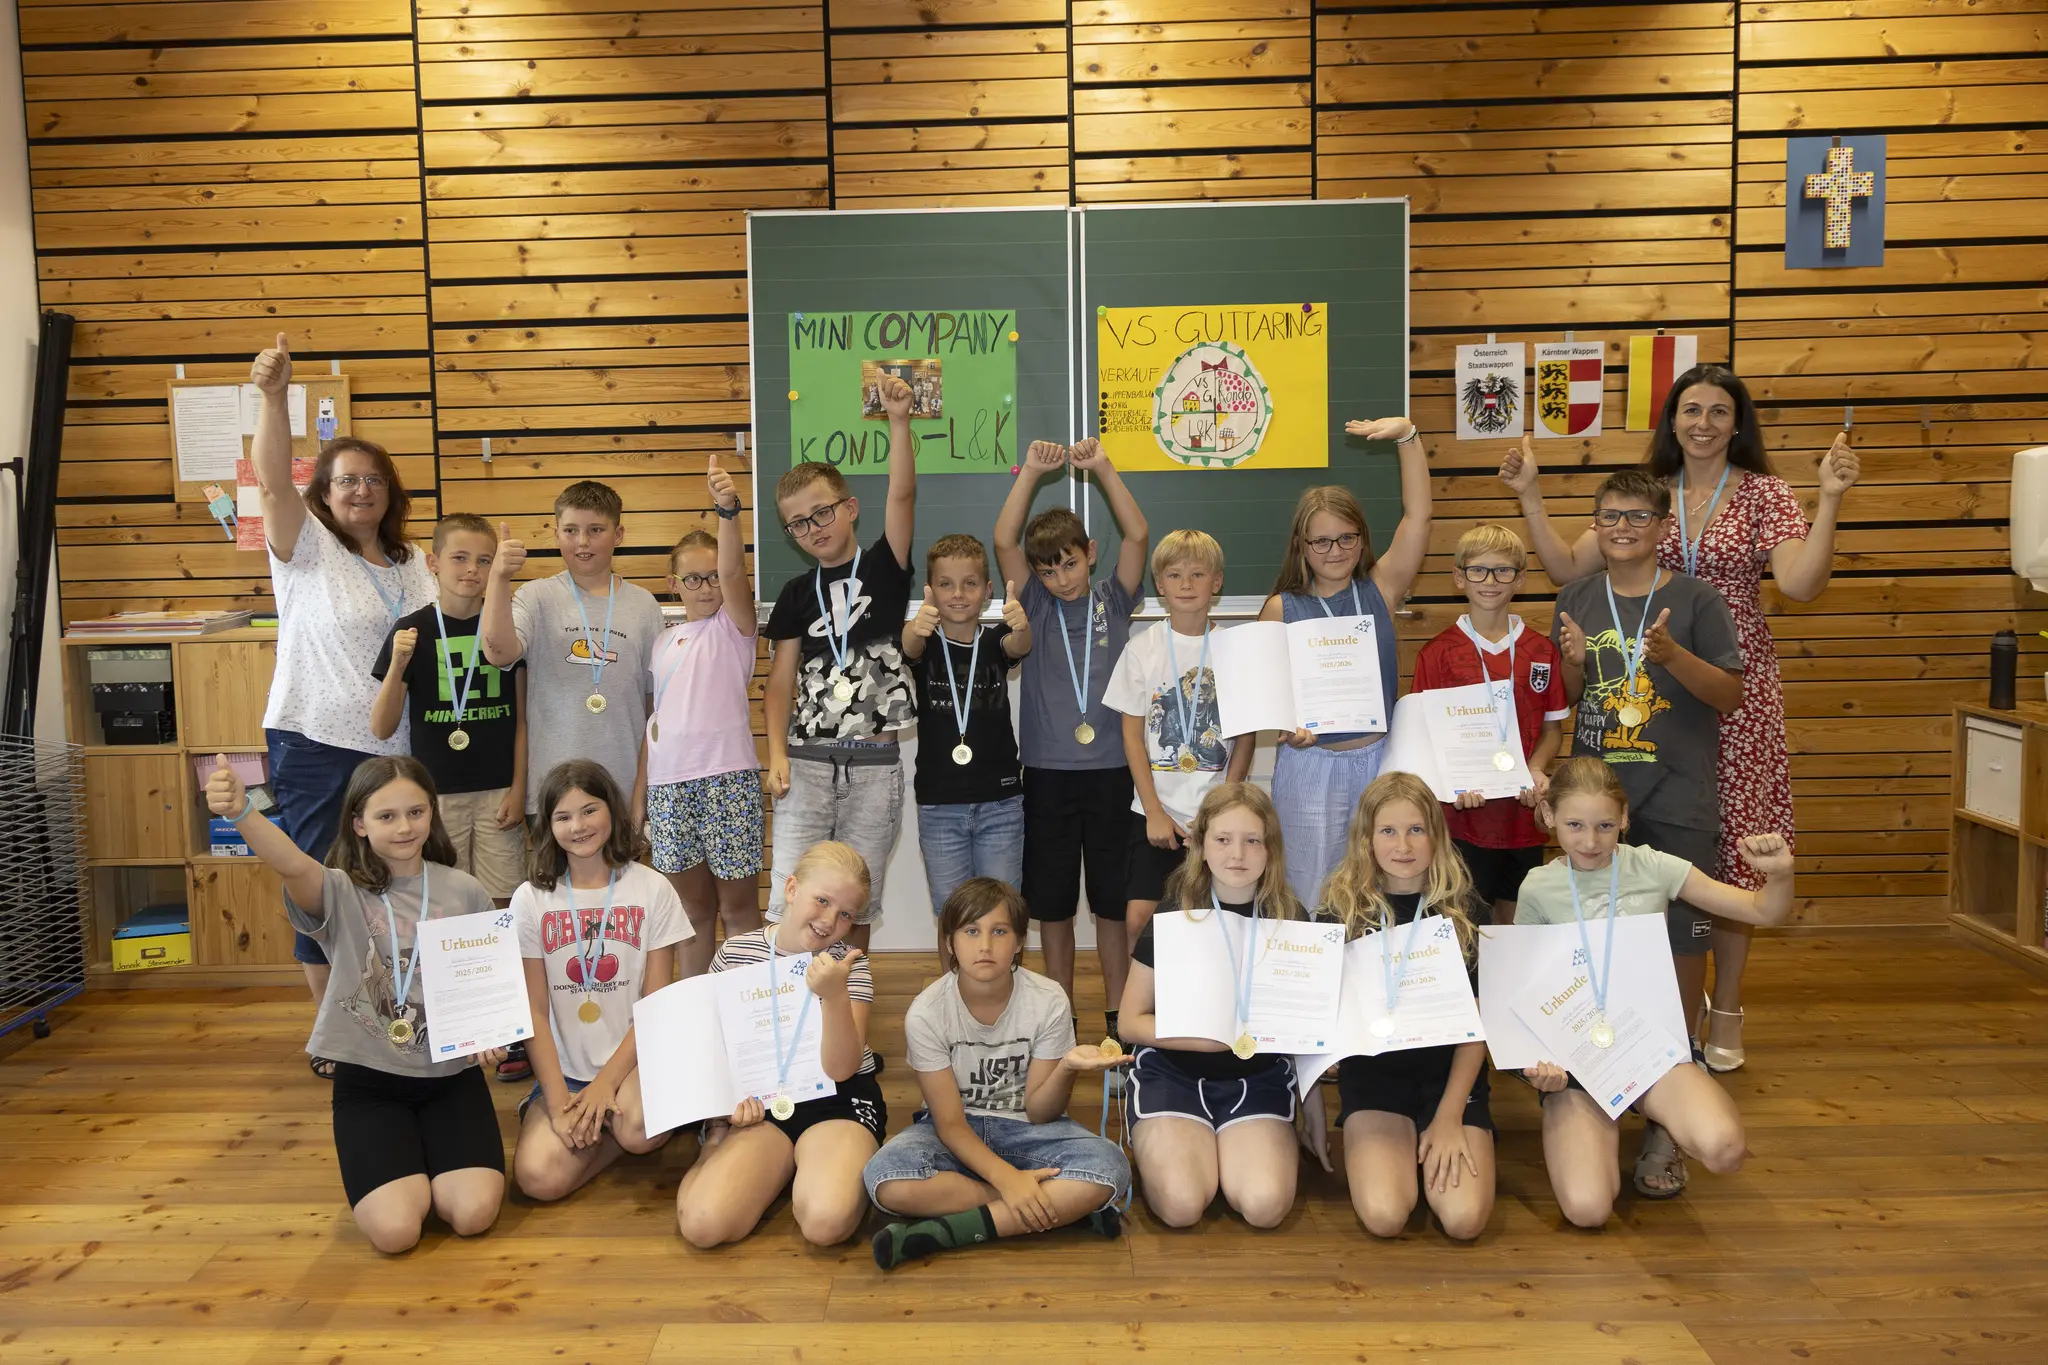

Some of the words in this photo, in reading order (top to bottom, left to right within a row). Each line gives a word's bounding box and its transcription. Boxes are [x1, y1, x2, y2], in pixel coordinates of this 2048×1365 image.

[794, 313, 853, 350] MINI
[864, 312, 1009, 355] COMPANY
[1105, 315, 1157, 349] VS
[1174, 310, 1324, 344] GUTTARING
[1473, 348, 1508, 357] Österreich
[1541, 347, 1570, 356] Kärntner
[1571, 347, 1599, 357] Wappen
[1467, 360, 1514, 370] Staatswappen
[1100, 367, 1160, 383] VERKAUF
[1193, 376, 1209, 389] VS
[1202, 389, 1213, 403] G
[1188, 419, 1213, 442] L&K
[1308, 635, 1359, 648] Urkunde
[424, 704, 511, 723] MINECRAFT
[1446, 703, 1498, 717] Urkunde
[1584, 714, 1607, 727] HAPPY
[541, 906, 645, 954] CHERRY
[441, 933, 499, 952] Urkunde
[1265, 938, 1324, 955] Urkunde
[454, 965, 493, 978] 2025/2026
[1272, 968, 1311, 979] 2025/2026
[553, 983, 577, 991] DOING
[1539, 974, 1589, 1018] Urkunde
[754, 1014, 792, 1029] 2025/026
[970, 1054, 1025, 1085] JUST
